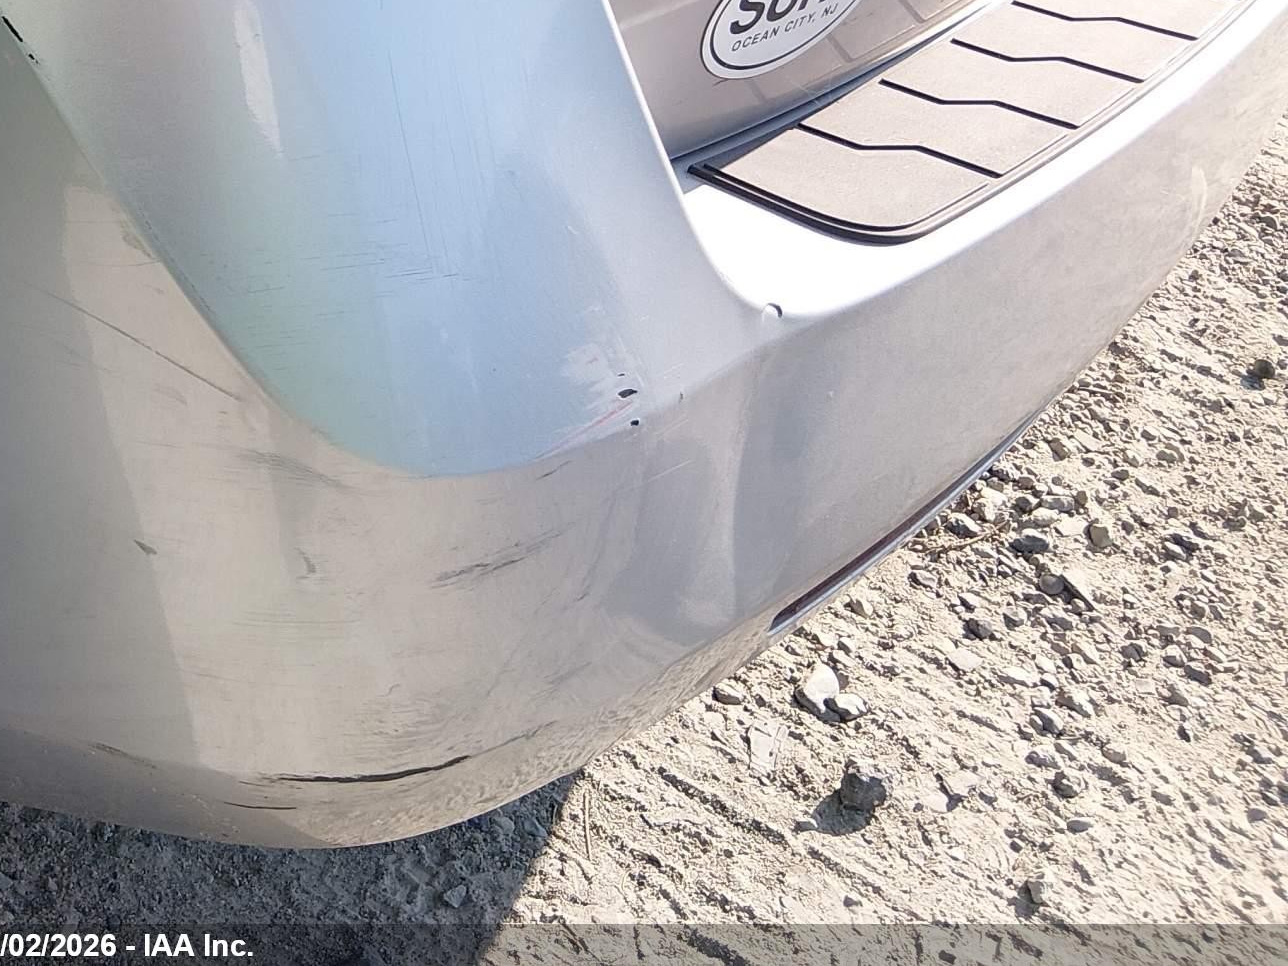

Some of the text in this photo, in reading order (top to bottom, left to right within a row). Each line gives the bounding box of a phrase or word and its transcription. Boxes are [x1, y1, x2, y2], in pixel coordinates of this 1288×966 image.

[731, 3, 839, 52] OCEAN CITY, NJ
